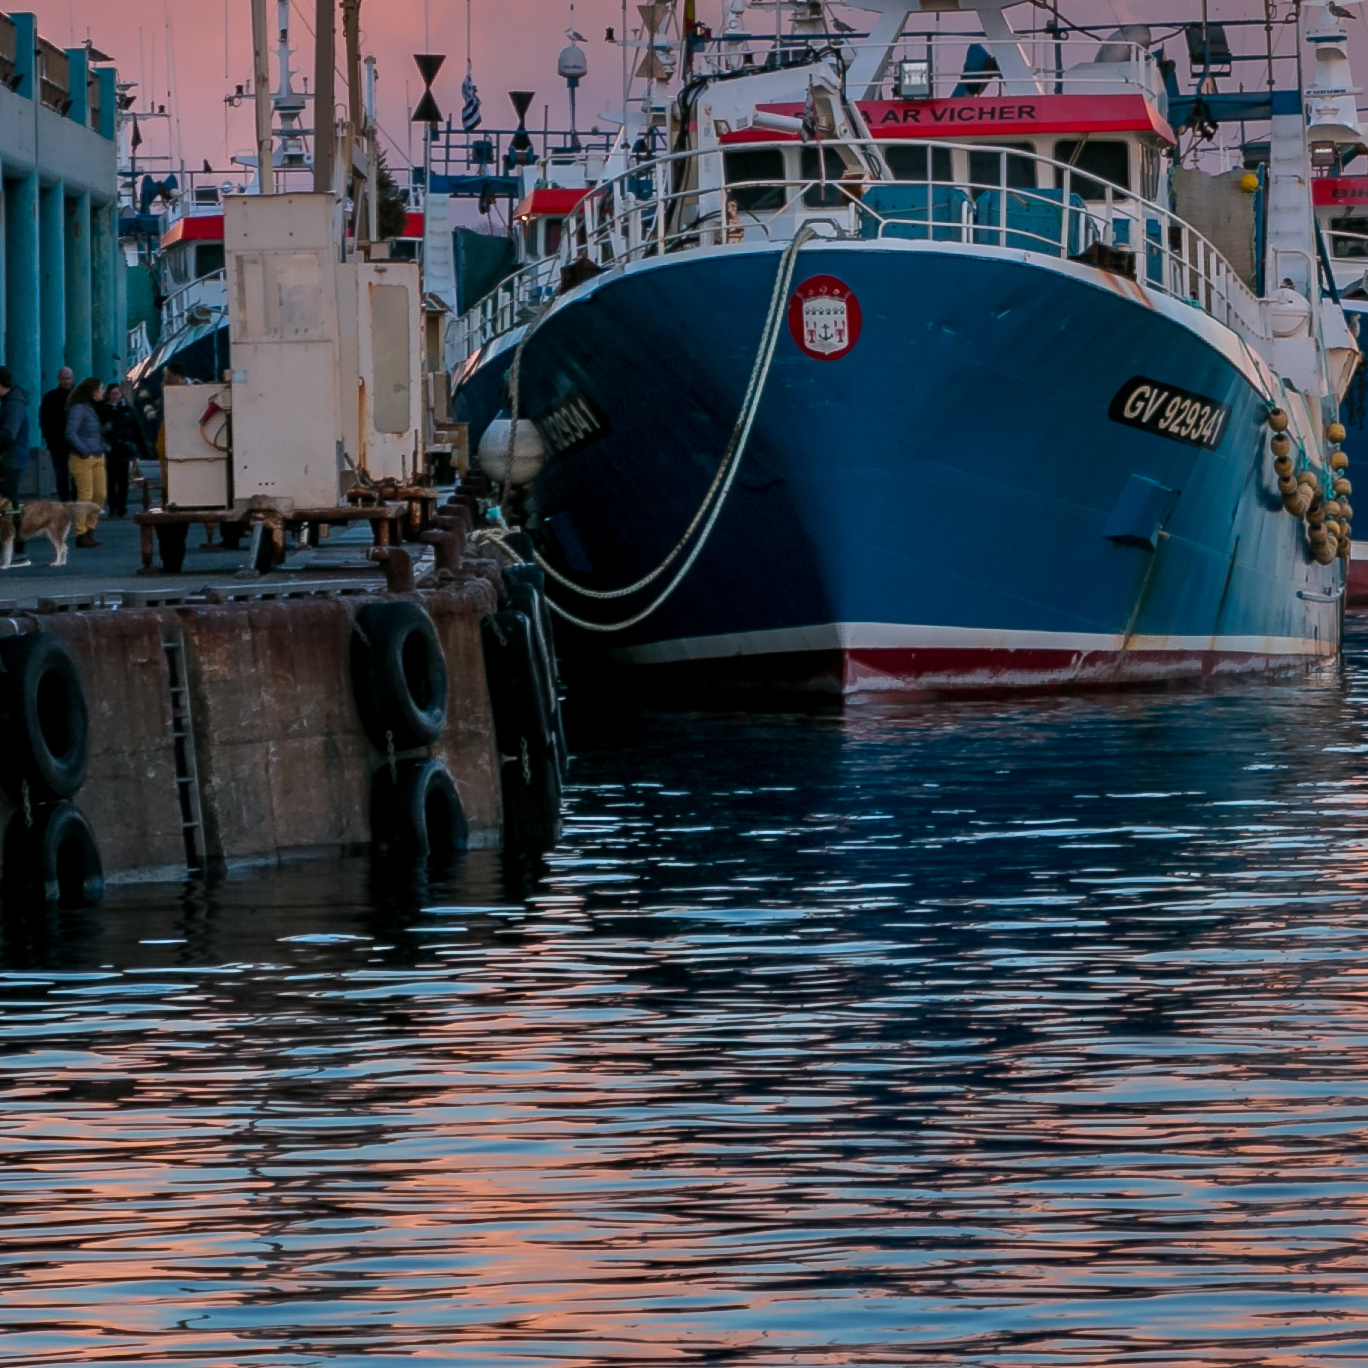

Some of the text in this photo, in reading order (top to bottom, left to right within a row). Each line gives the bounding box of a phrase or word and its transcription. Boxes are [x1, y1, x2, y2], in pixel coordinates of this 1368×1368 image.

[880, 109, 921, 124] AR
[930, 104, 1037, 122] VICHER
[1123, 385, 1226, 445] GV 929341
